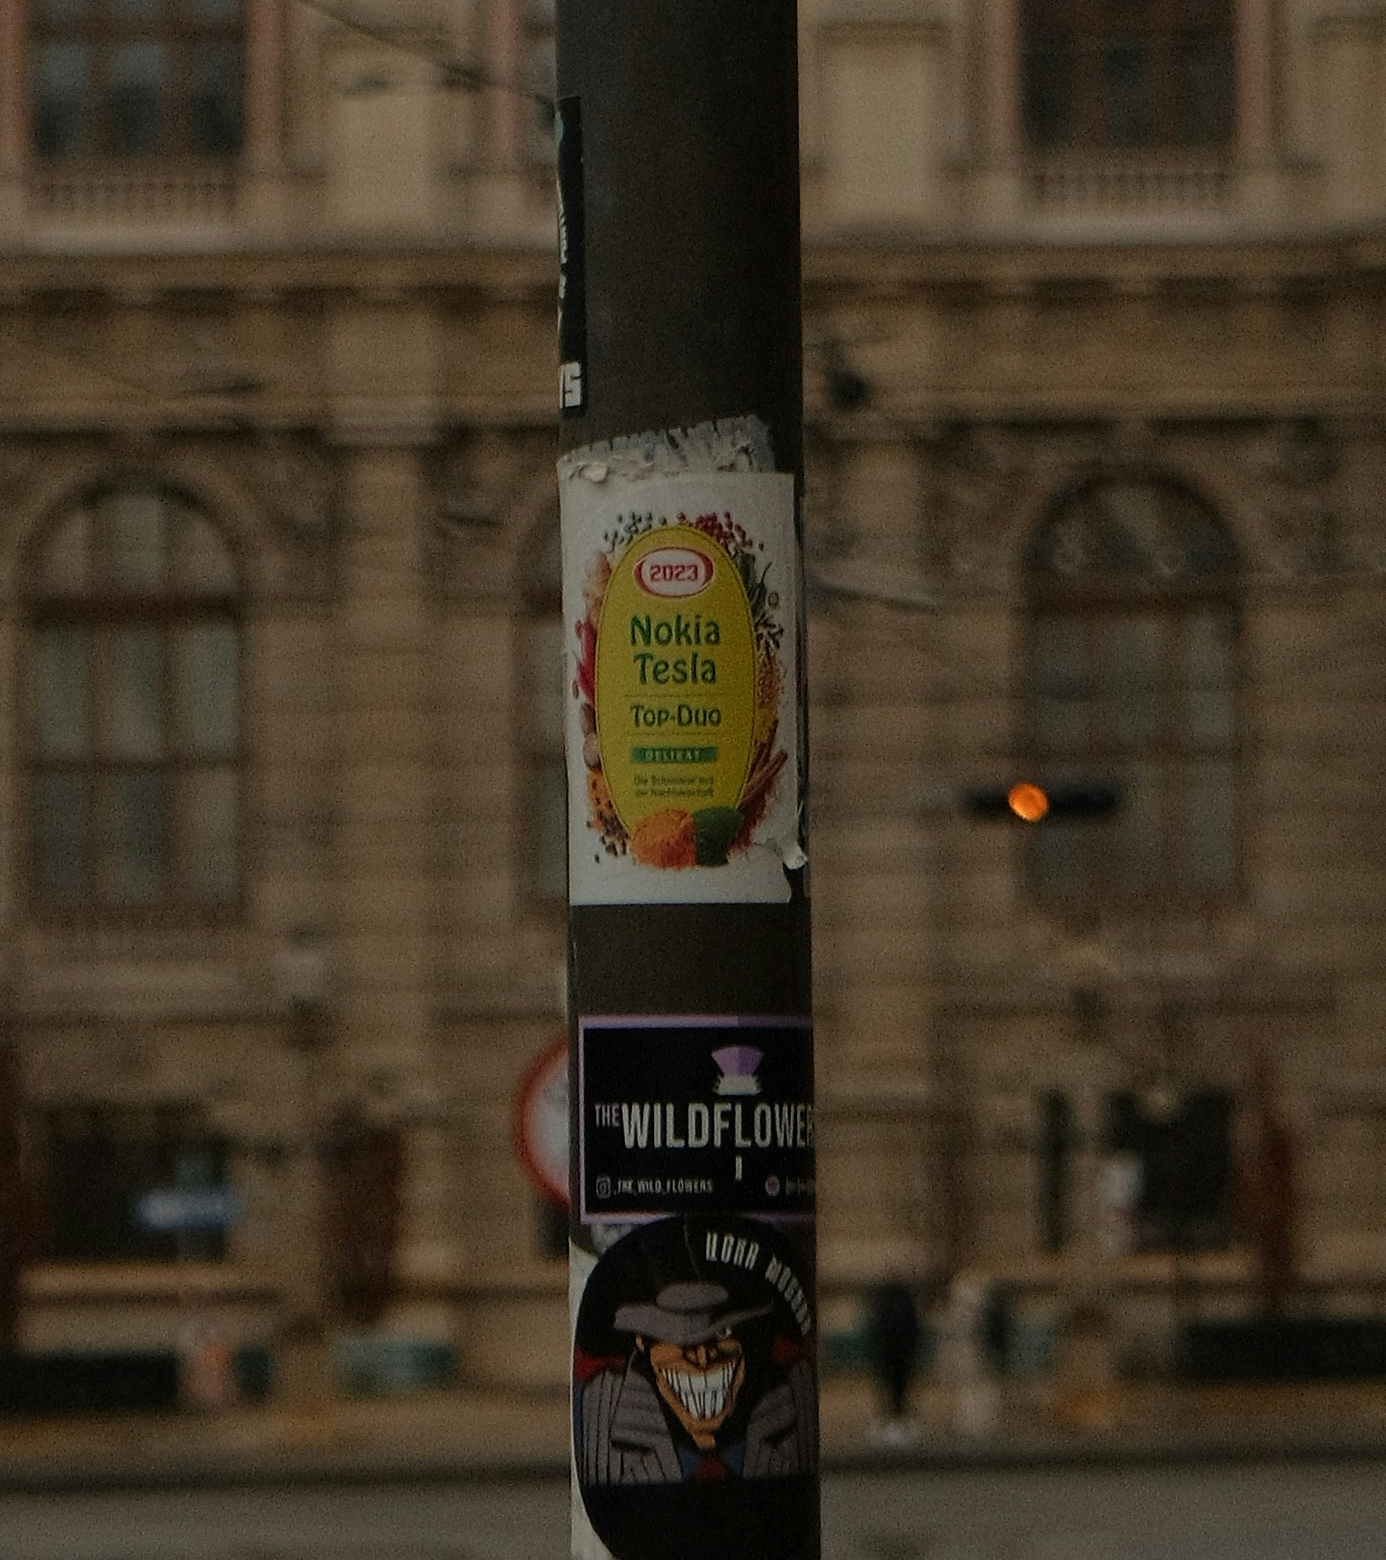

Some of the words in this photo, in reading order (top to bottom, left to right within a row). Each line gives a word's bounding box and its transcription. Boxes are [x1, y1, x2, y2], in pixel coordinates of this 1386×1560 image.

[649, 563, 699, 583] 2023
[630, 614, 721, 647] Nokia
[633, 650, 717, 685] Tesla
[630, 704, 722, 729] Top-Duo
[594, 1102, 620, 1128] THE
